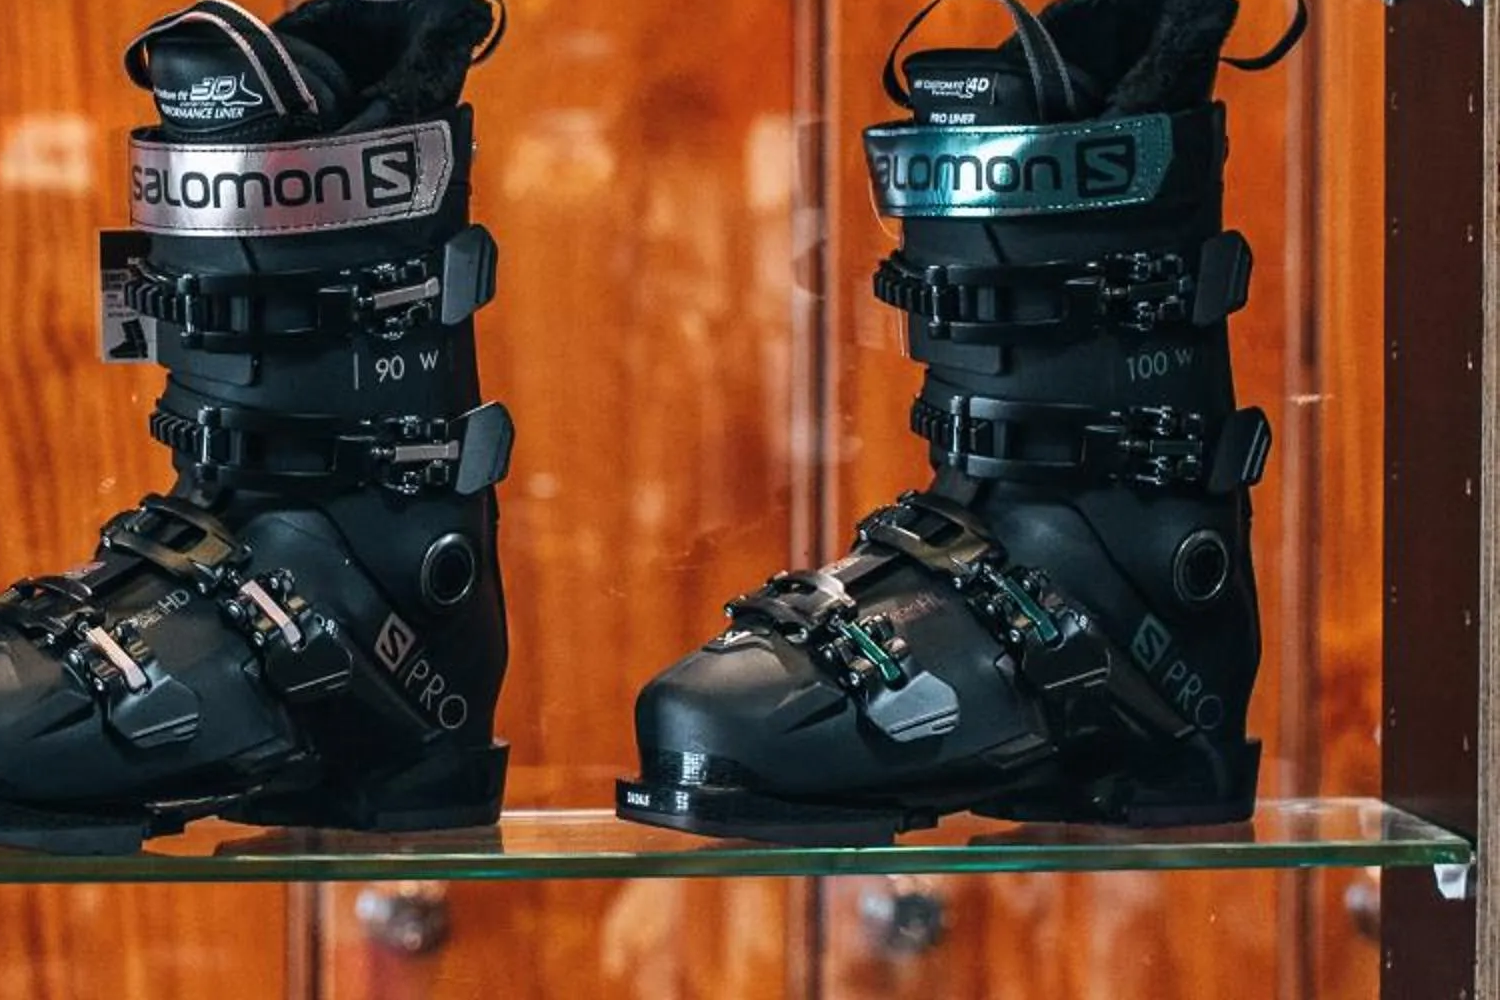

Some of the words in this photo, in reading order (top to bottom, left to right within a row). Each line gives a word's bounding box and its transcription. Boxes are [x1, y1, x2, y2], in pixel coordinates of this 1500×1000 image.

[190, 75, 238, 101] 3D
[966, 77, 990, 93] 4D
[214, 107, 245, 119] LINER
[929, 112, 947, 124] PRO
[948, 112, 976, 125] LINER
[132, 164, 352, 209] salomon
[375, 354, 405, 383] 90
[419, 348, 440, 371] W
[1125, 350, 1168, 383] 100
[157, 588, 191, 615] HD
[403, 658, 469, 730] PRO
[1160, 659, 1225, 731] PRO
